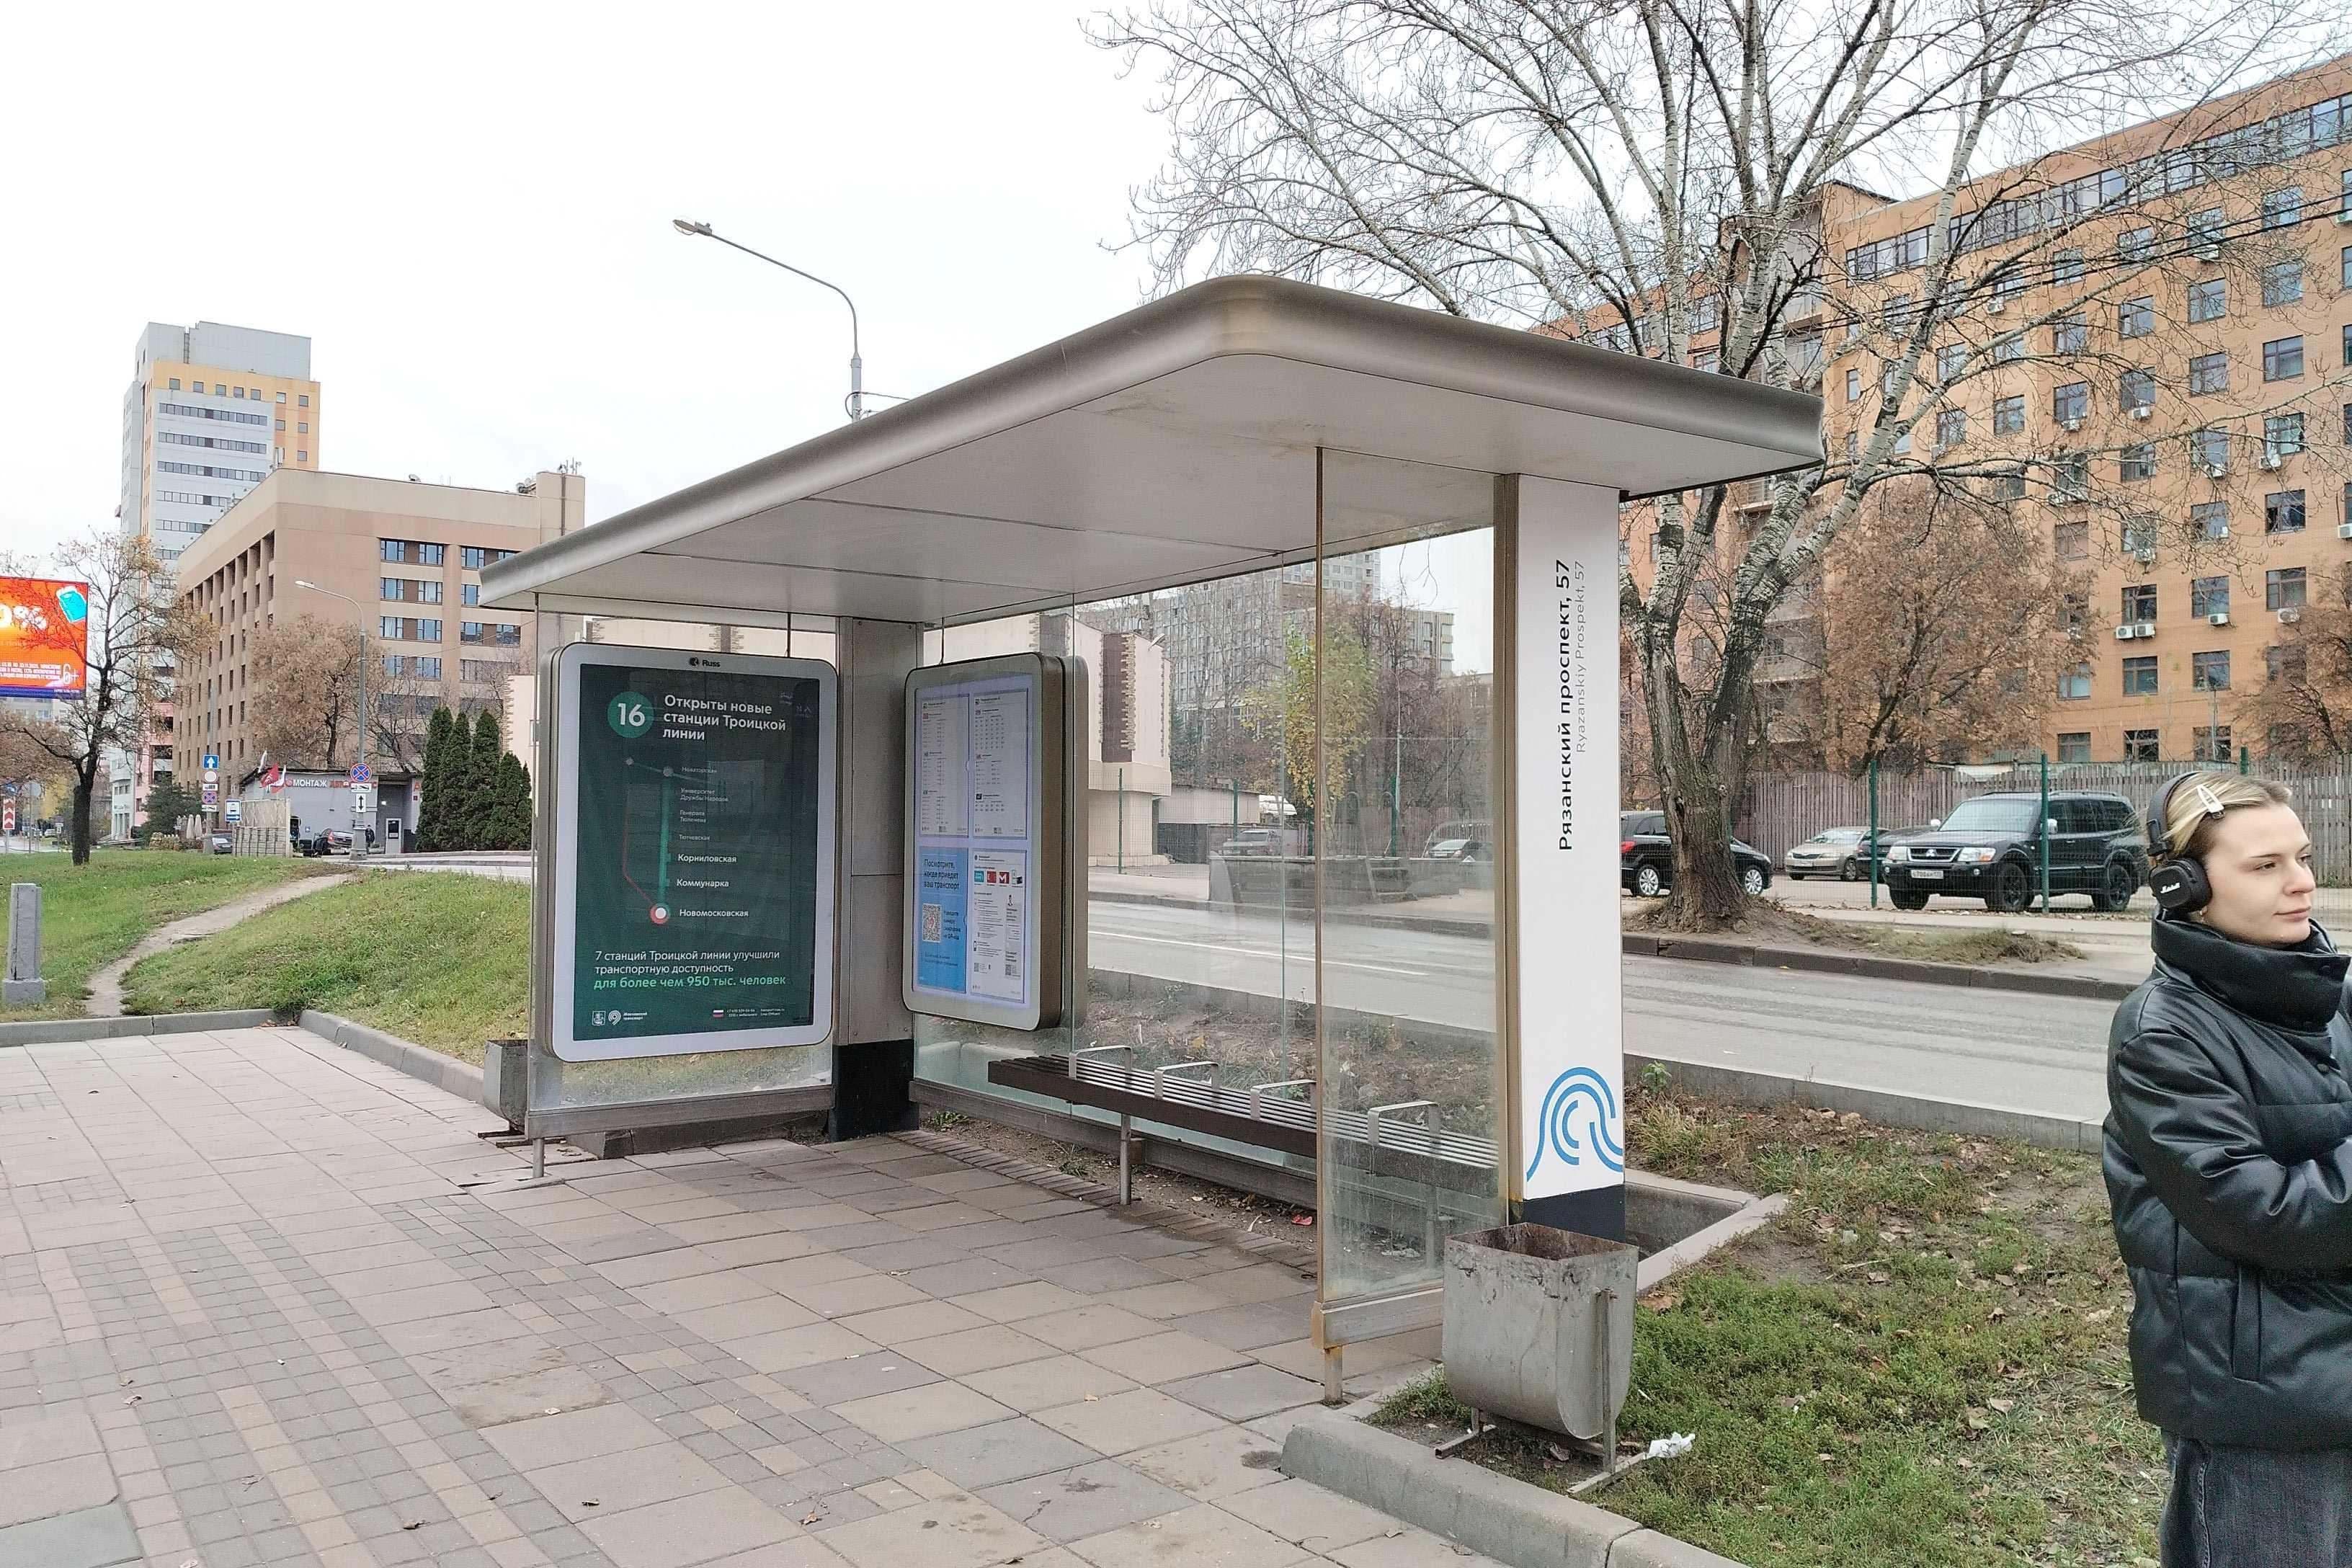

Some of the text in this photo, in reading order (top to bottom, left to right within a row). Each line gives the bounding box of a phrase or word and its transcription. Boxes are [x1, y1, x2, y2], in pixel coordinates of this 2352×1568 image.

[1574, 560, 1587, 753] Ryazanskiy Prospekt, 57
[63, 664, 80, 685] 6+
[664, 695, 772, 714] Открыты новые
[1556, 559, 1574, 850] Рязанский проспект, 57
[617, 703, 645, 727] 16
[663, 713, 786, 731] станции Троицкой
[663, 730, 705, 741] линии
[678, 854, 737, 863] Корниловская
[677, 878, 729, 888] Коммунарка
[680, 909, 749, 917] Новомосковская
[595, 950, 780, 962] 7 станций Троицкой линии улучшили
[594, 963, 734, 976] транспортную доступность
[594, 975, 785, 991] для более чем 950 тыс. человек
